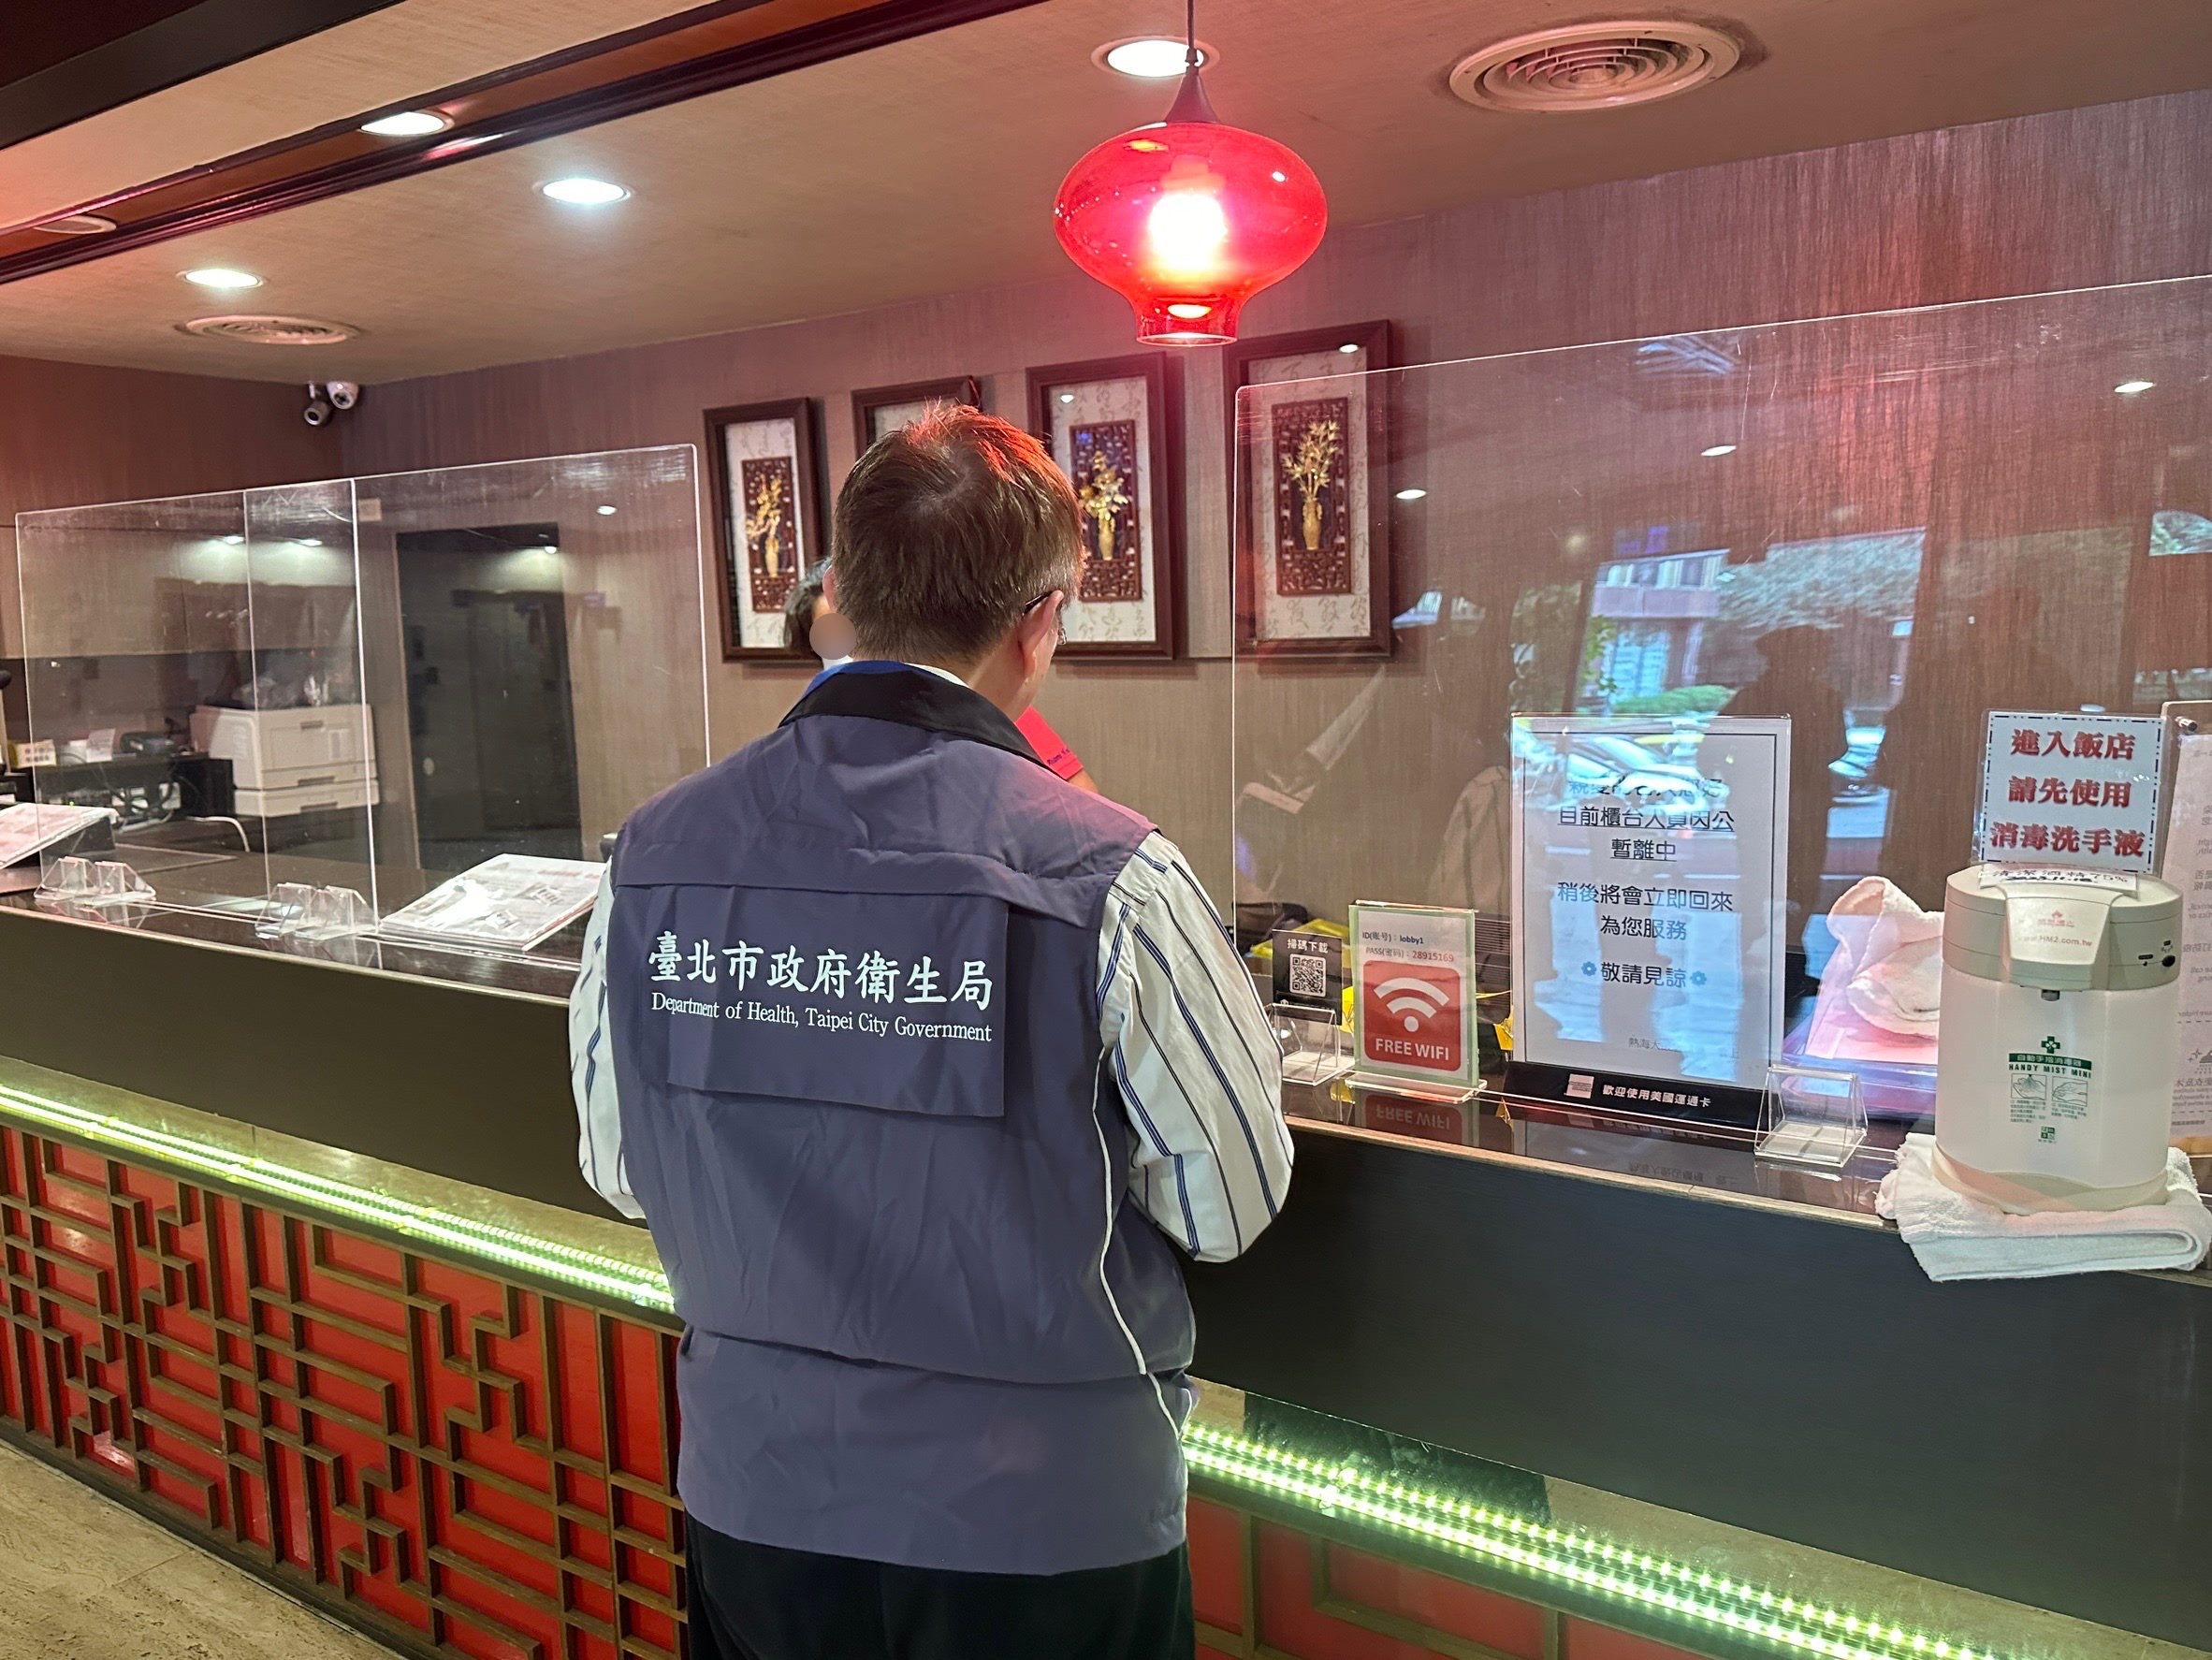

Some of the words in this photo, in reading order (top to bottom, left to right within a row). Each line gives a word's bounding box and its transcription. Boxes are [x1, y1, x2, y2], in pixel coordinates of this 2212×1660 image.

[2011, 729, 2136, 761] 進入飯店
[2008, 776, 2132, 808] 請先使用
[1560, 806, 1735, 832] 目前櫃台人員因公
[1611, 838, 1677, 860] 暫離中
[1990, 822, 2146, 857] 消毒洗手液
[1558, 882, 1733, 911] 稍後將會立即回來
[1600, 915, 1687, 940] 為您服務
[648, 930, 994, 1012] 臺北市政府衛生局
[1601, 962, 1686, 988] 敬請見諒
[651, 992, 720, 1019] Department
[725, 1003, 743, 1020] of
[749, 1003, 799, 1028] Health,
[805, 1007, 853, 1031] Taipei
[858, 1013, 888, 1038] City
[895, 1016, 992, 1041] Government
[1375, 1039, 1412, 1056] FREE
[1415, 1043, 1449, 1061] WIFI
[2009, 1063, 2039, 1071] HANDY
[2044, 1065, 2067, 1074] MIST
[2071, 1069, 2092, 1079] MINI
[1603, 1084, 1711, 1108] 歡迎使用美國運通卡
